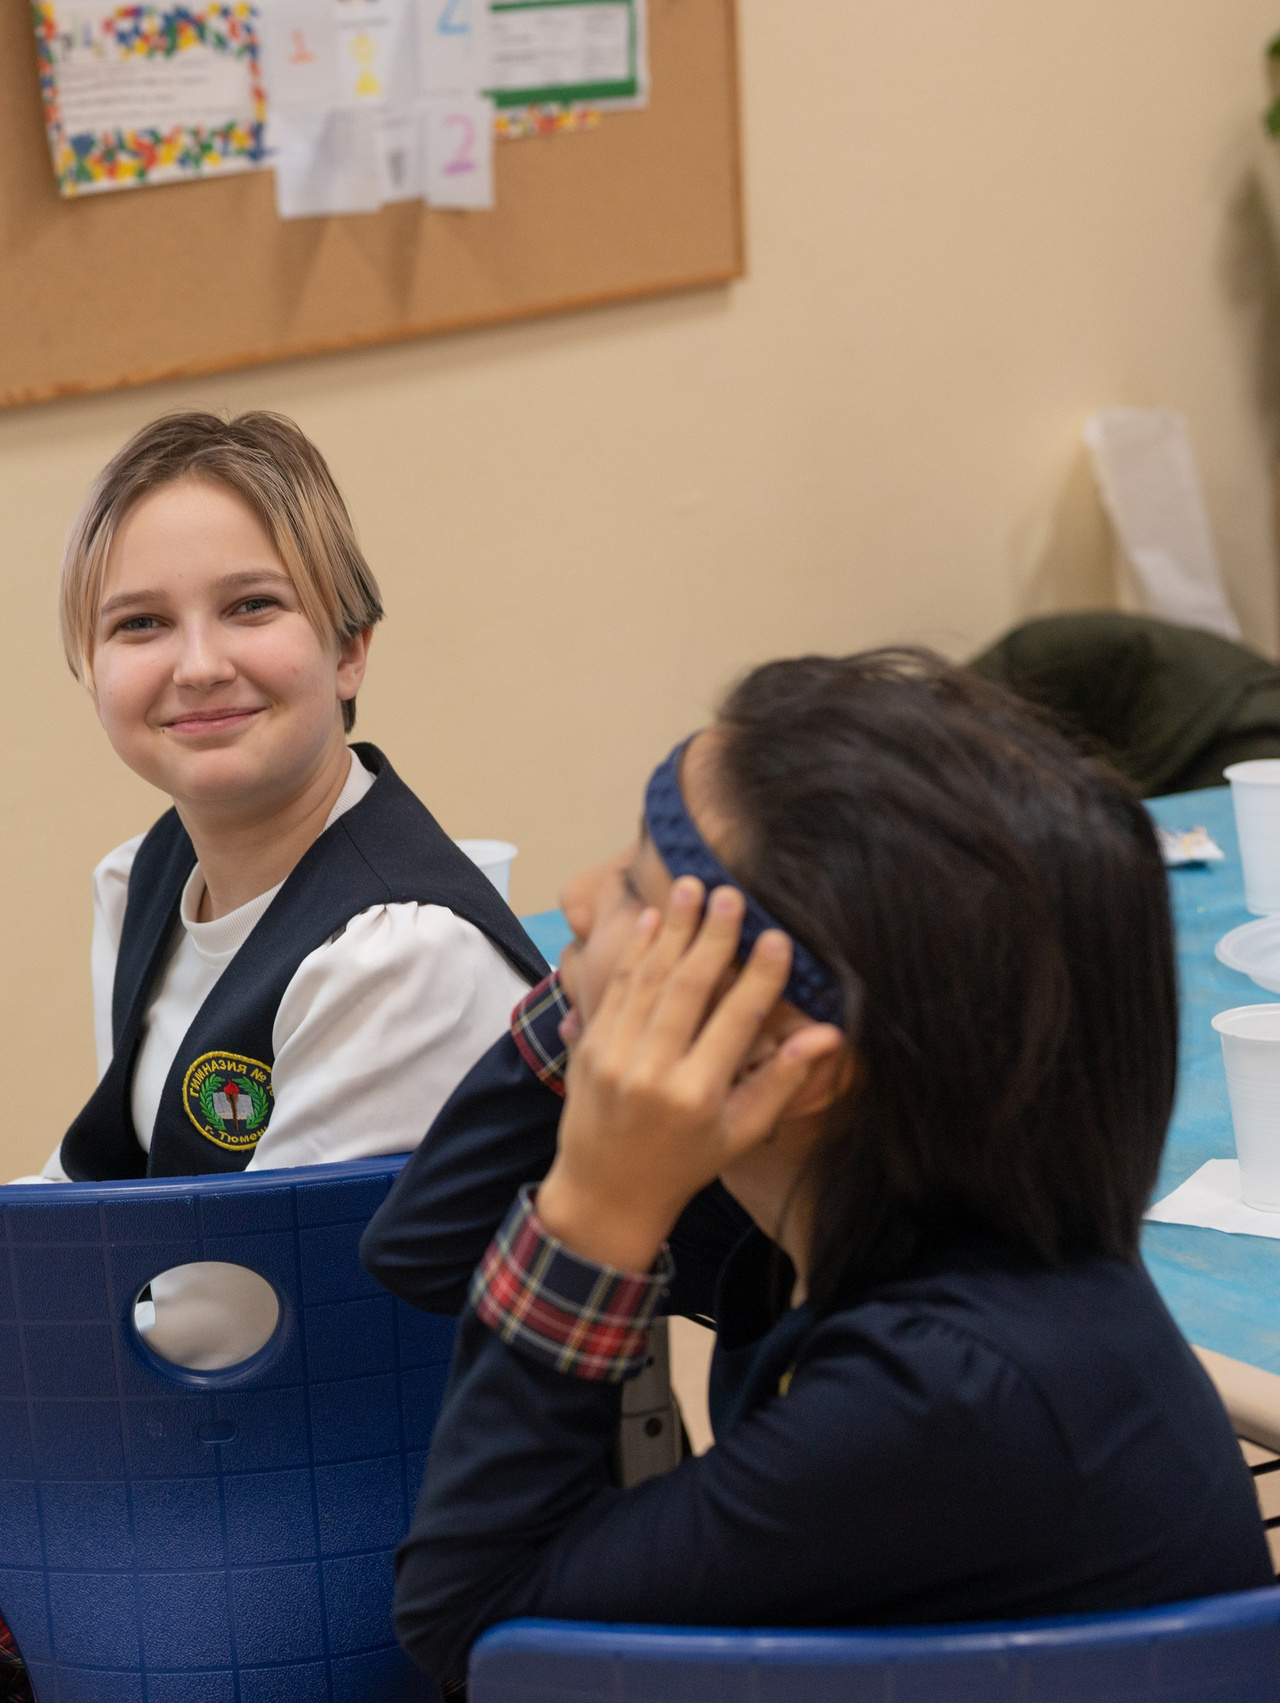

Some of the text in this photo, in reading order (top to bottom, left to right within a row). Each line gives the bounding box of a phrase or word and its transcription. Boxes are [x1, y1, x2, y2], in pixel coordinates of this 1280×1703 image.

[443, 113, 476, 176] 2
[190, 1059, 247, 1097] ГИМНАЗИЯ
[250, 1068, 267, 1082] №
[219, 1127, 268, 1143] Тюмен
